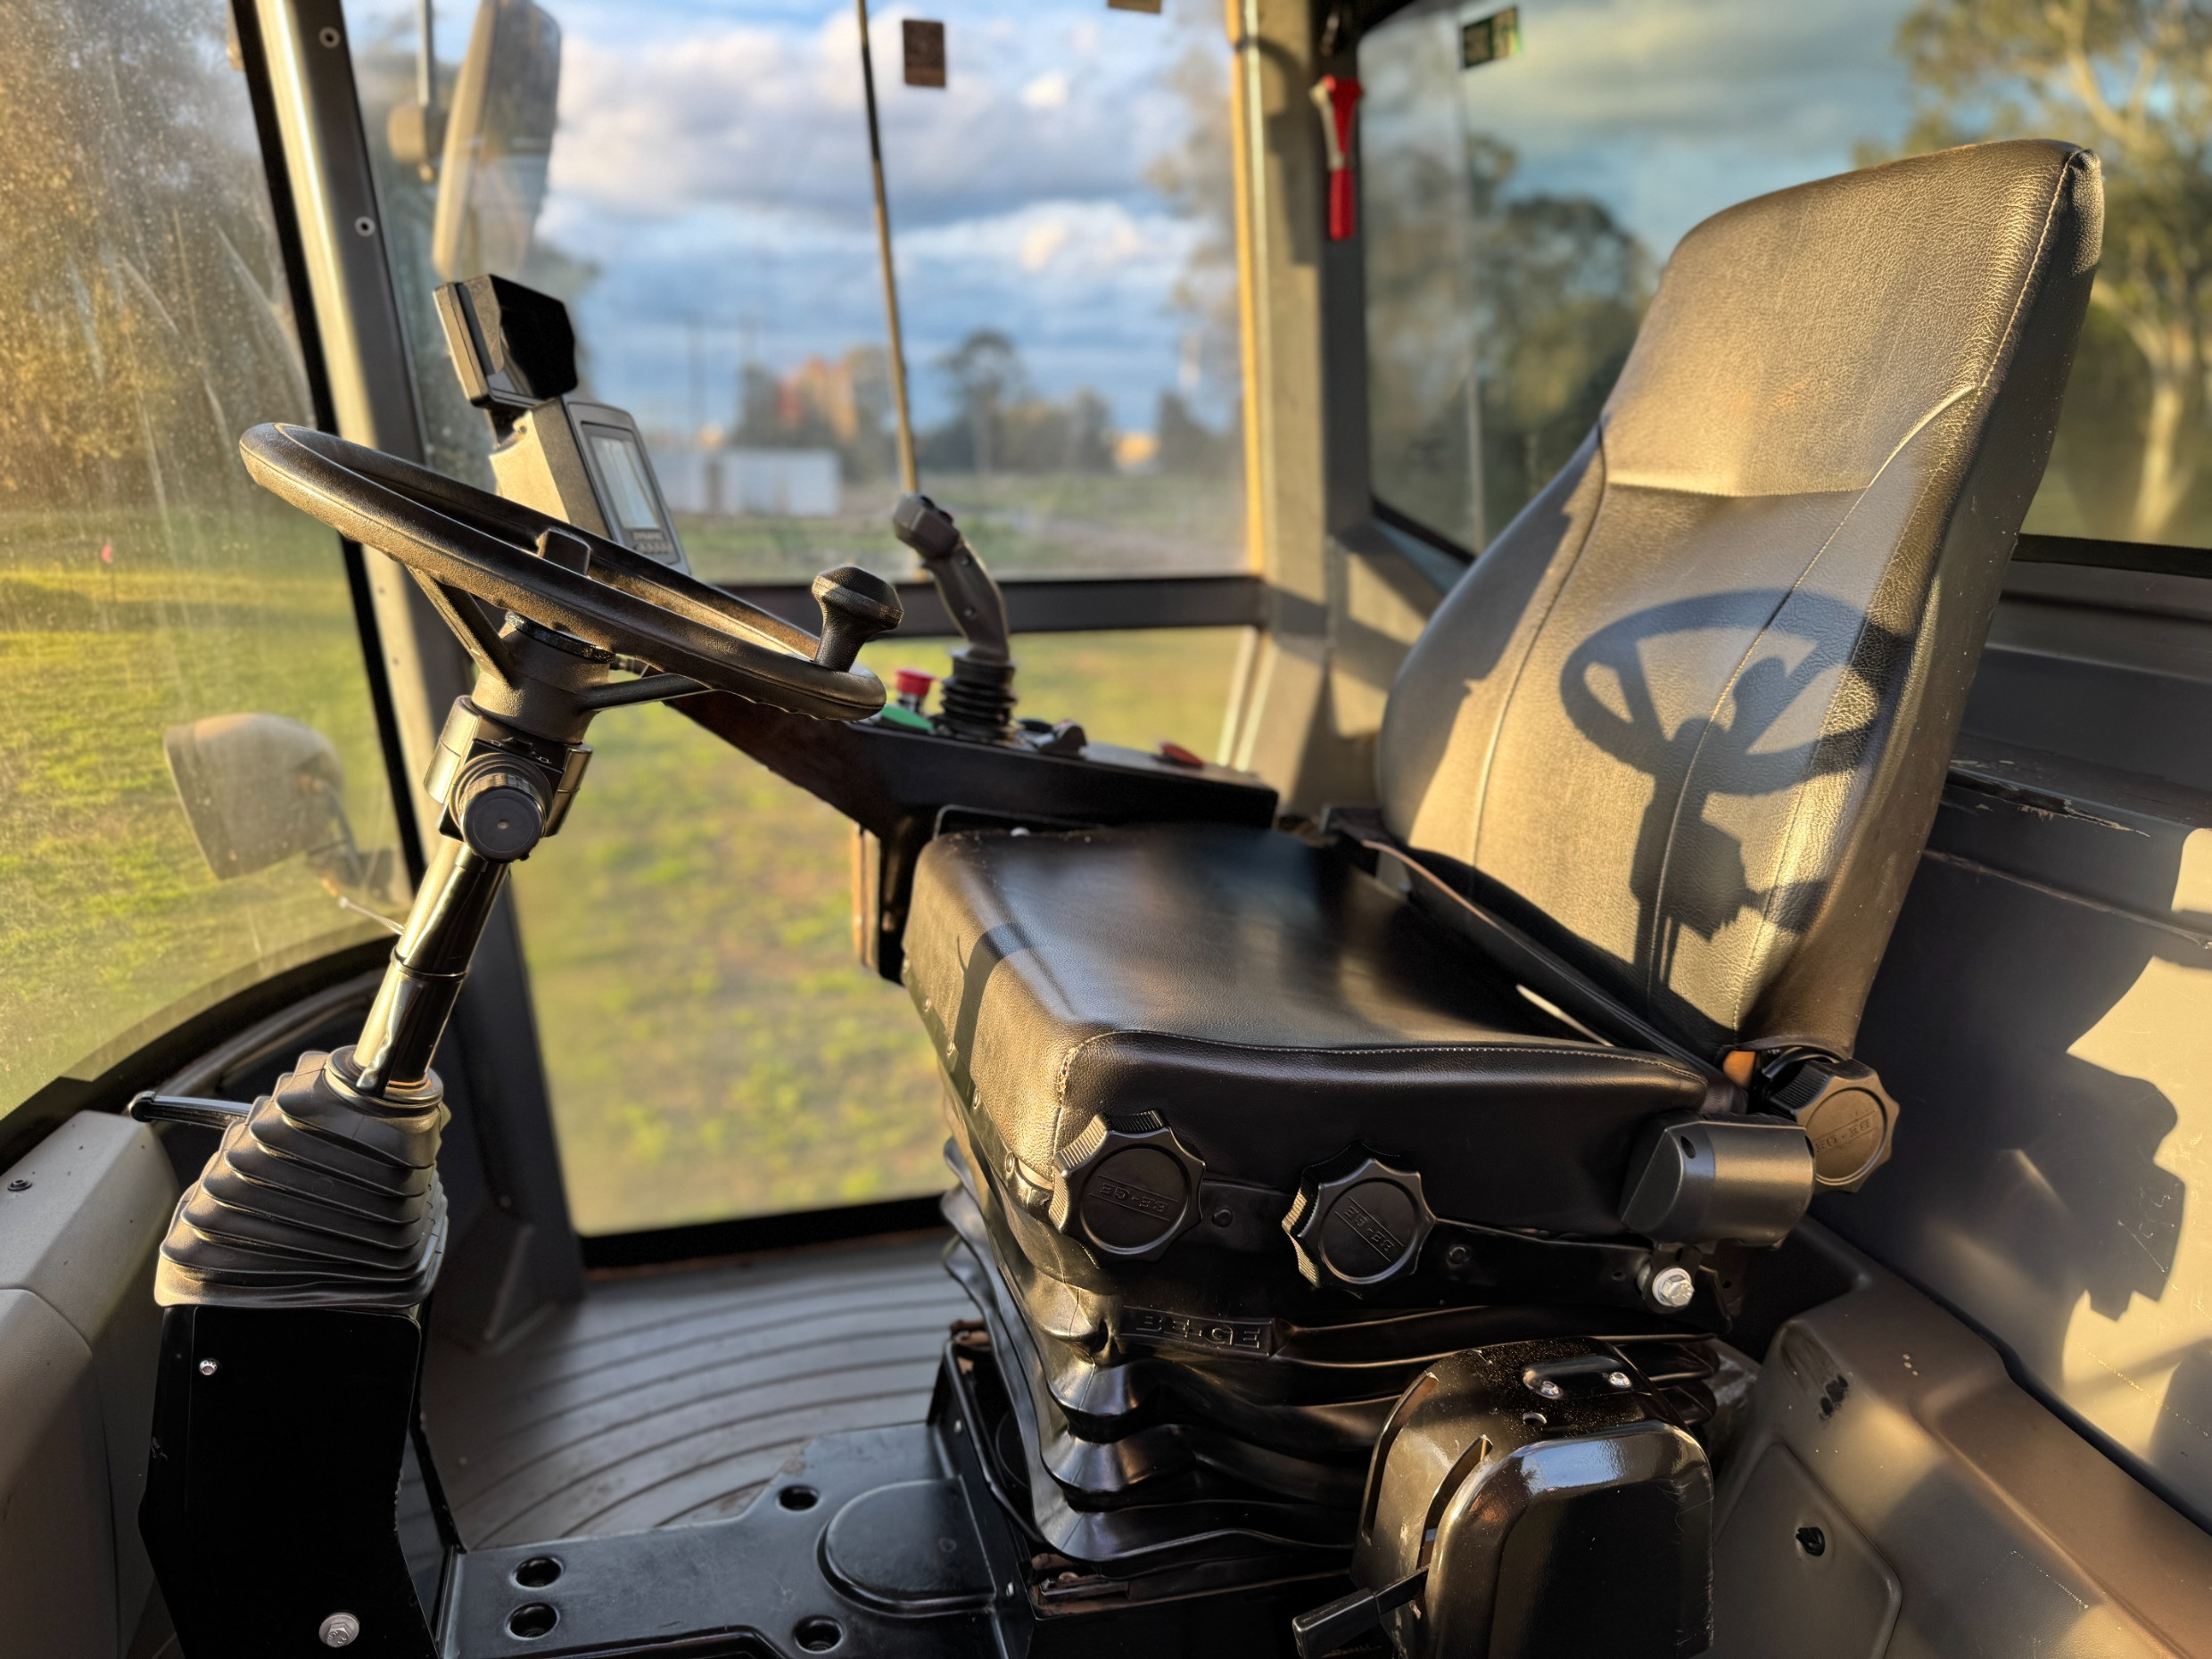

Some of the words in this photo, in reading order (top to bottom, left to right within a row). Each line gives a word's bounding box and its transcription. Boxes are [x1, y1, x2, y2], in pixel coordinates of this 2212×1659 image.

[1099, 1182, 1169, 1213] BE-GE
[1344, 1205, 1396, 1252] BE-GE
[1135, 1314, 1260, 1349] BE-GE
